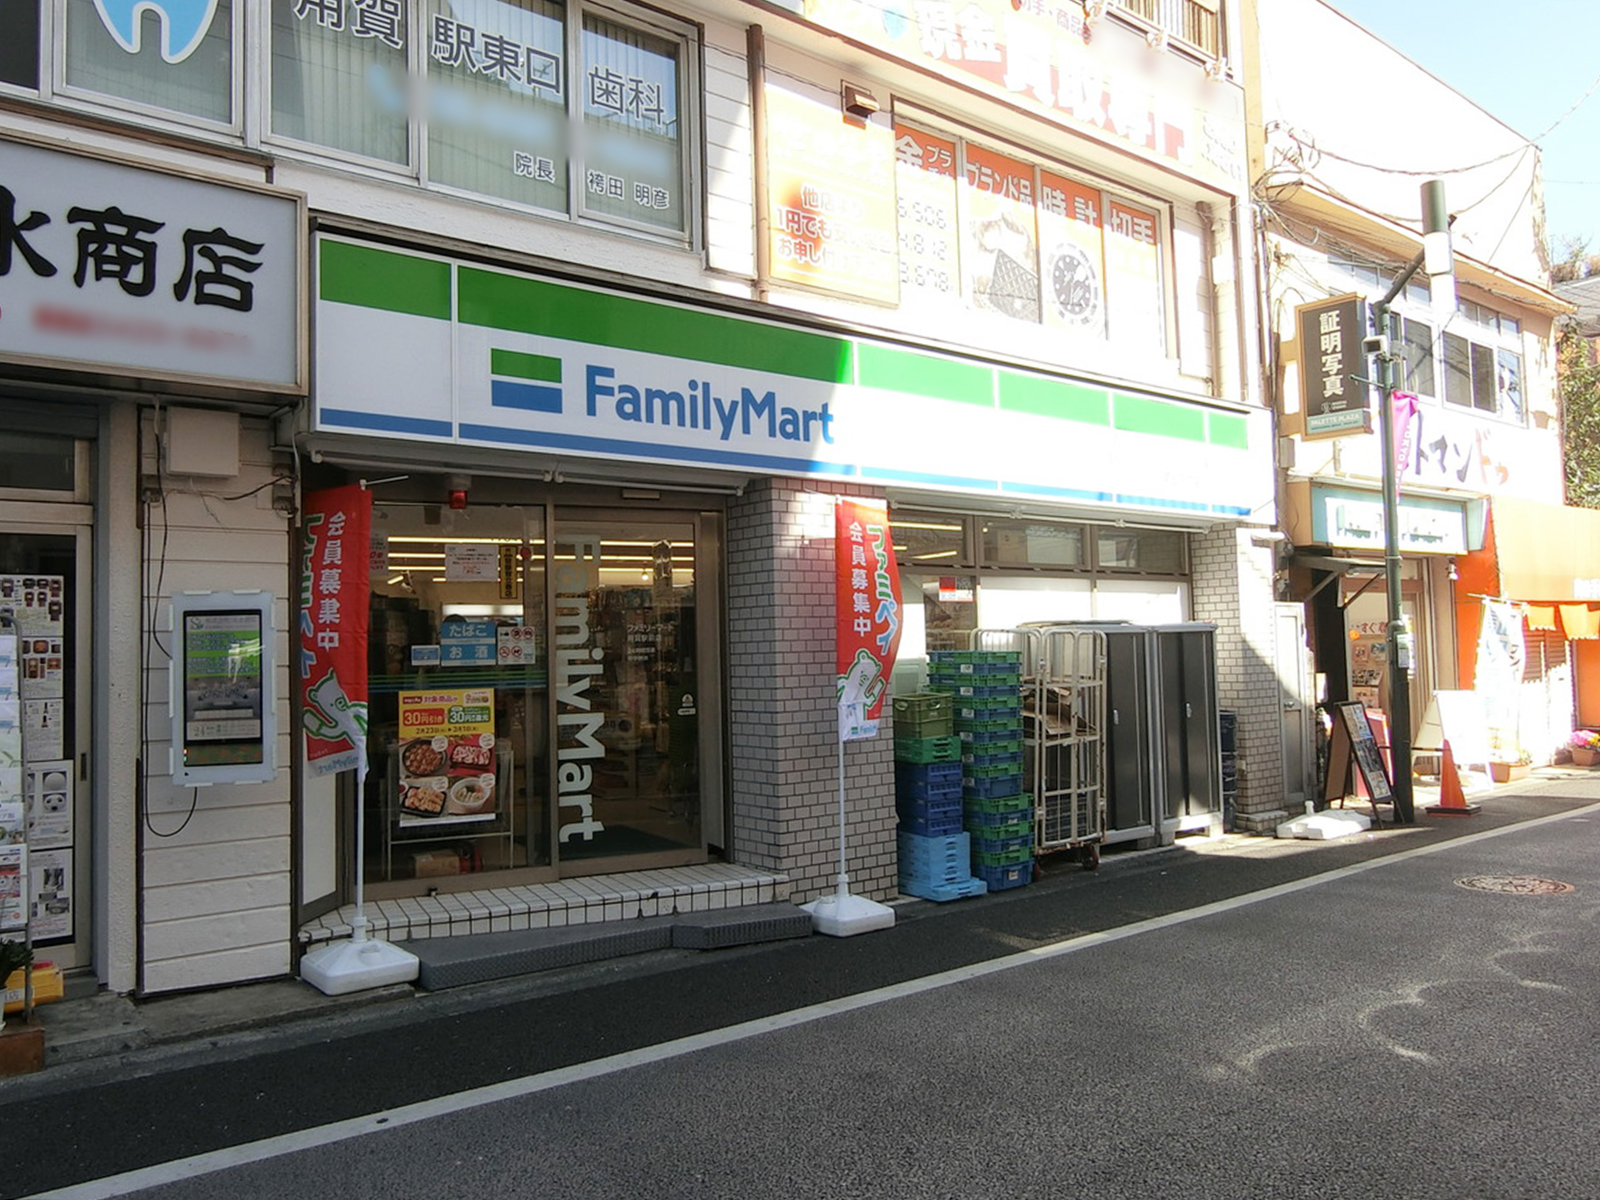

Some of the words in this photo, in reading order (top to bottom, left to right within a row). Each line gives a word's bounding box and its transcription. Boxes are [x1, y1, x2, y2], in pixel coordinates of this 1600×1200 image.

[431, 15, 564, 95] 駅東口
[587, 65, 666, 126] 歯科
[513, 151, 556, 183] 院長
[634, 184, 670, 209] 明彦
[1041, 185, 1099, 227] 時計
[1110, 207, 1154, 245] 切手
[1319, 309, 1344, 398] 証明写真
[585, 364, 834, 445] FamilyMart
[849, 521, 871, 638] 会員募集中
[866, 524, 898, 656] ファミペイ
[449, 625, 487, 637] たばこ
[449, 646, 489, 659] お酒
[553, 533, 606, 845] FamilyMart
